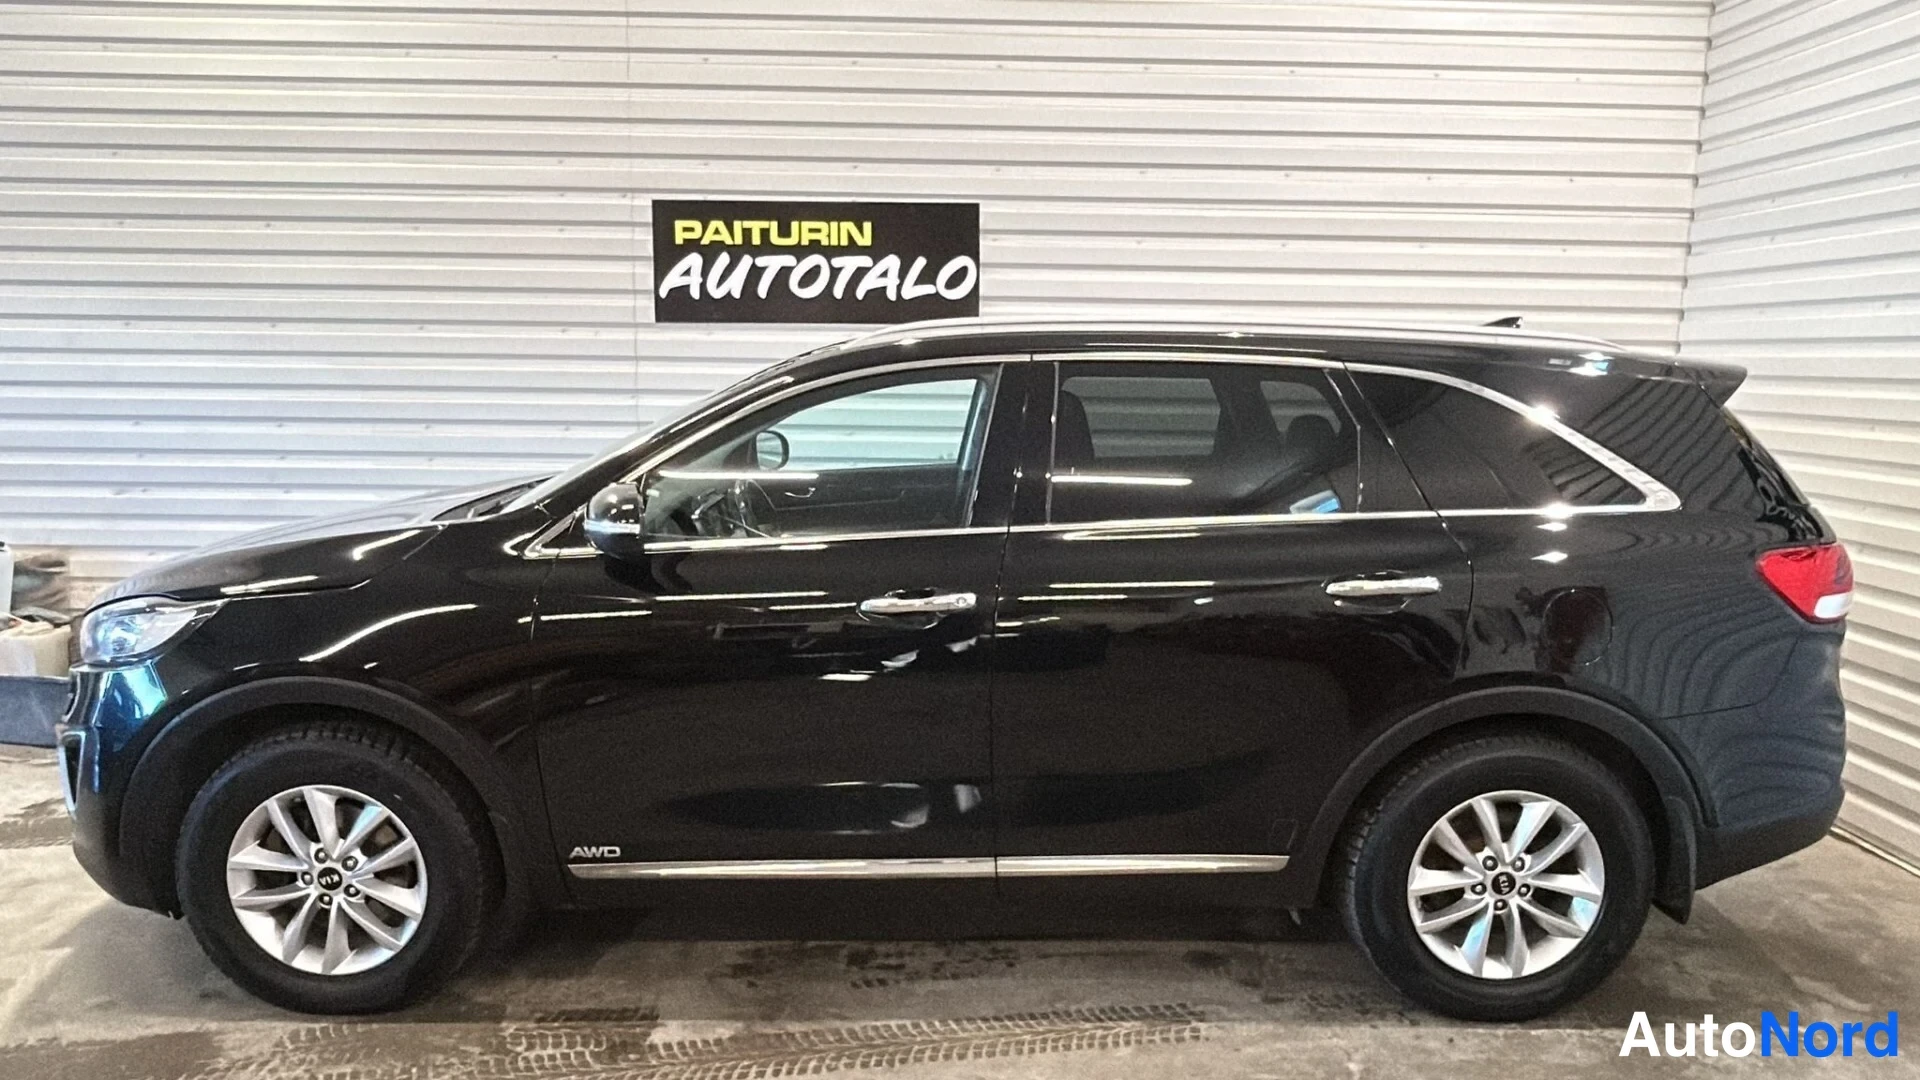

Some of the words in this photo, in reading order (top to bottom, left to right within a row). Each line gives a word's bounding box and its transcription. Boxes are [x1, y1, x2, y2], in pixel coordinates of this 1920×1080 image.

[674, 219, 873, 247] PAITURIN
[658, 251, 978, 302] AUTOTALO
[569, 846, 621, 858] AWD
